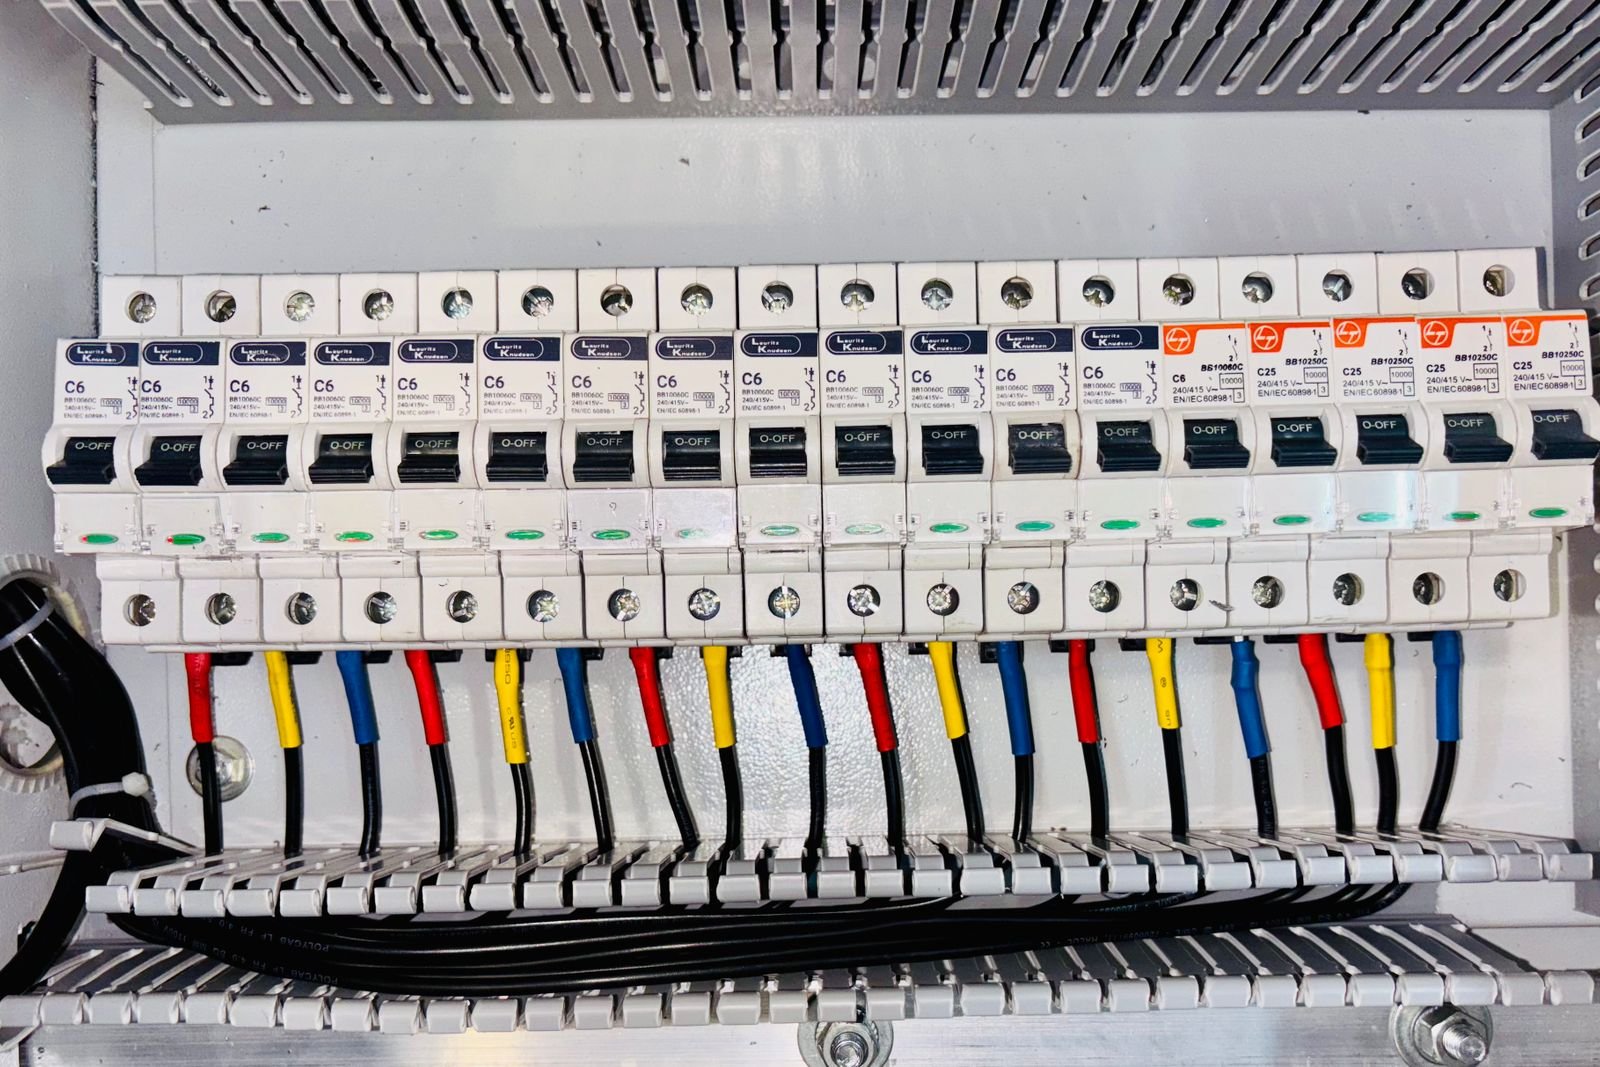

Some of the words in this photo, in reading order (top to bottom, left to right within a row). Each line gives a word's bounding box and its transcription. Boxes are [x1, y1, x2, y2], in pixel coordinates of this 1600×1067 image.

[1371, 357, 1413, 365] BB10250C
[1542, 351, 1584, 359] BB10250C
[1286, 358, 1328, 366] BB10250C
[1427, 364, 1445, 373] C25
[1513, 361, 1532, 370] C25
[826, 370, 846, 383] C6
[912, 370, 932, 383] C6
[996, 369, 1016, 382] C6
[1084, 367, 1103, 380] C6
[1257, 367, 1276, 376] C25
[1305, 371, 1327, 379] 10000
[1343, 367, 1361, 376] C25
[398, 378, 418, 391] C6
[484, 376, 504, 389] C6
[572, 376, 592, 389] C6
[657, 375, 677, 389] C6
[742, 373, 762, 386] C6
[1173, 374, 1185, 383] C6
[1221, 377, 1242, 385] 10000
[65, 380, 85, 394] C6
[142, 380, 161, 394] C6
[230, 380, 250, 393] C6
[314, 380, 334, 393] C6
